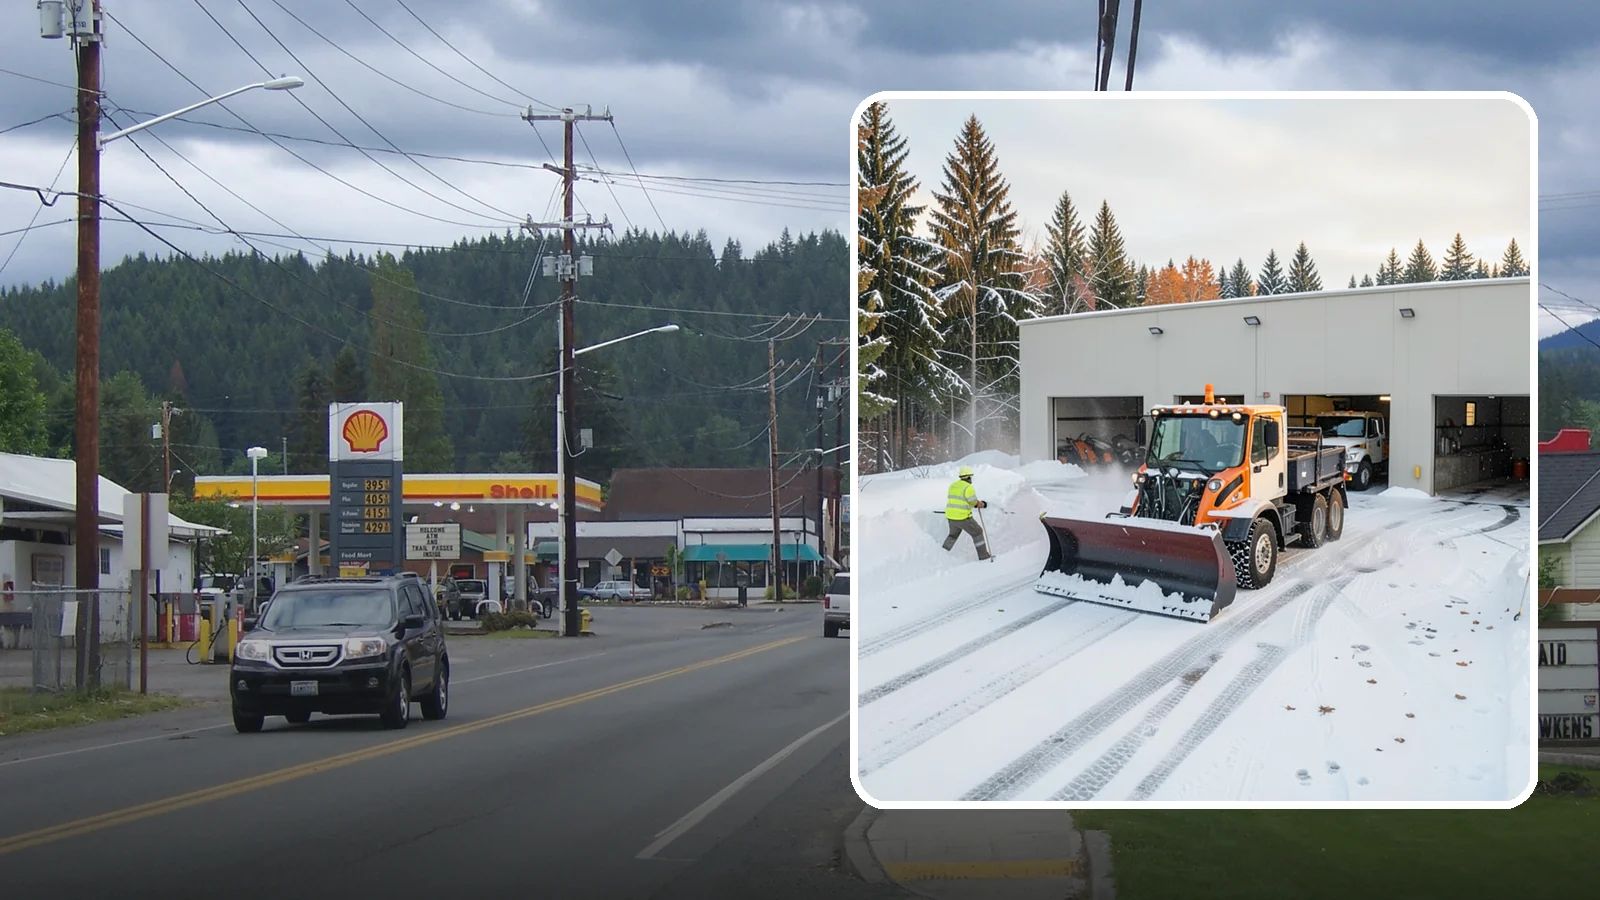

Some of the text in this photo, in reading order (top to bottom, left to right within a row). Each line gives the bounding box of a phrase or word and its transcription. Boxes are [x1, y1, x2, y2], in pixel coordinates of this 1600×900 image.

[365, 480, 384, 490] 395
[490, 484, 547, 499] Shell
[365, 494, 384, 504] 405
[365, 508, 384, 518] 415
[365, 522, 384, 533] 429
[1538, 642, 1567, 666] AID
